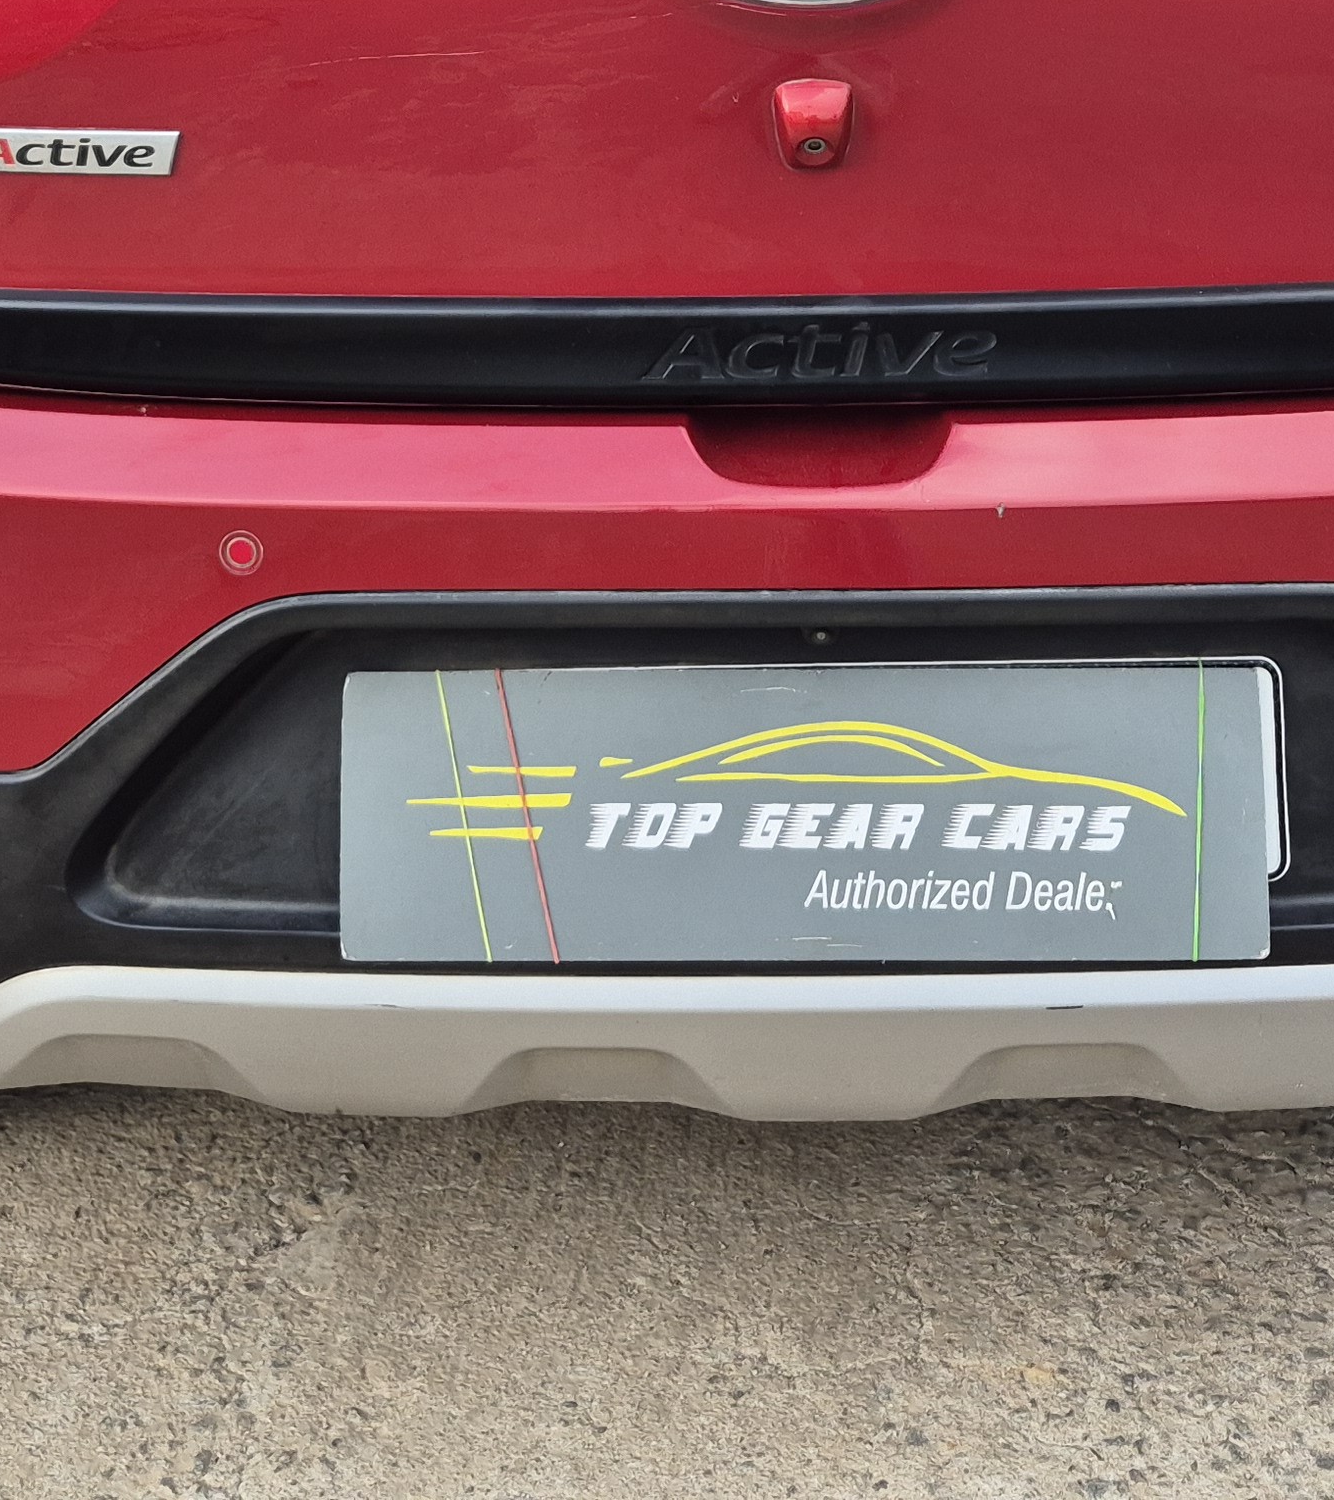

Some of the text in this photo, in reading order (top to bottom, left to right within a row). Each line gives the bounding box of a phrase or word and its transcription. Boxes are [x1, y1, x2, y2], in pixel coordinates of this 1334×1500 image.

[639, 322, 997, 381] Active
[585, 802, 1132, 852] TOP GEAR CARS
[803, 870, 995, 911] Authorized
